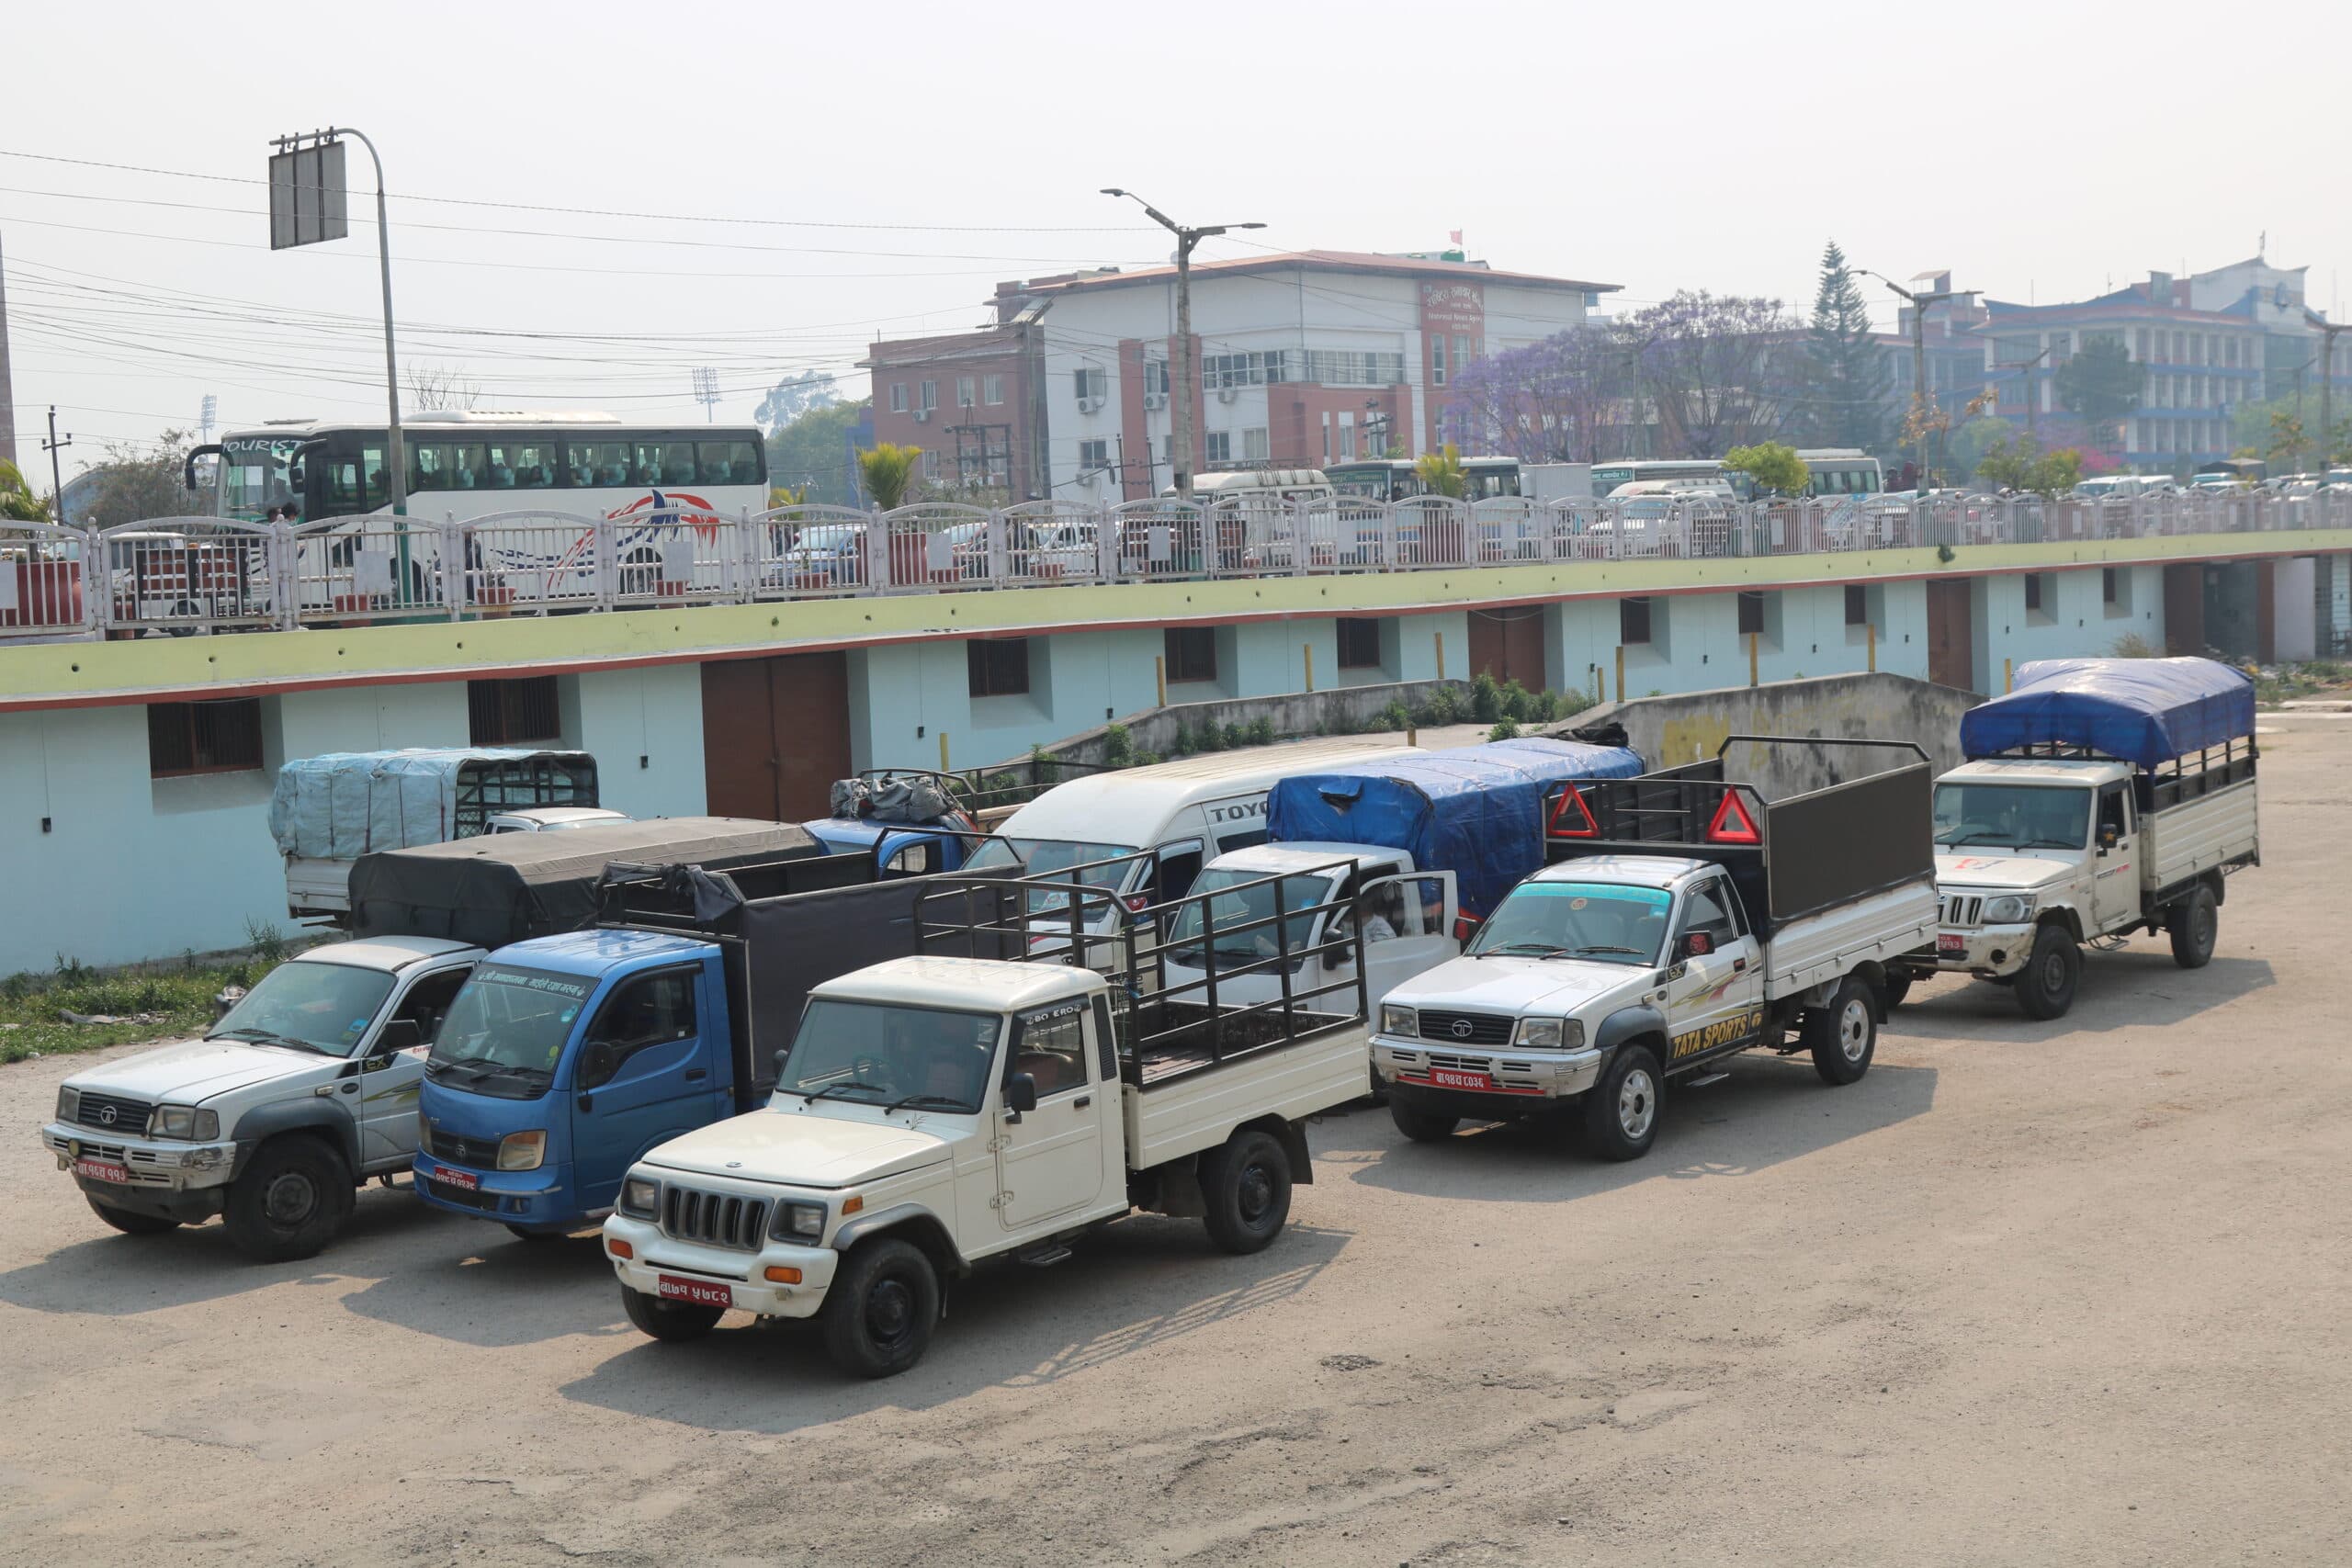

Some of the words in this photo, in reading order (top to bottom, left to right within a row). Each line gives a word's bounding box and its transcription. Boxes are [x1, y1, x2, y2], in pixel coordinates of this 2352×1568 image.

[221, 439, 307, 453] TOURIST
[1668, 965, 1683, 979] EX
[1674, 1030, 1701, 1059] TATA
[1702, 1015, 1747, 1049] SPORTS
[367, 1057, 385, 1069] EX
